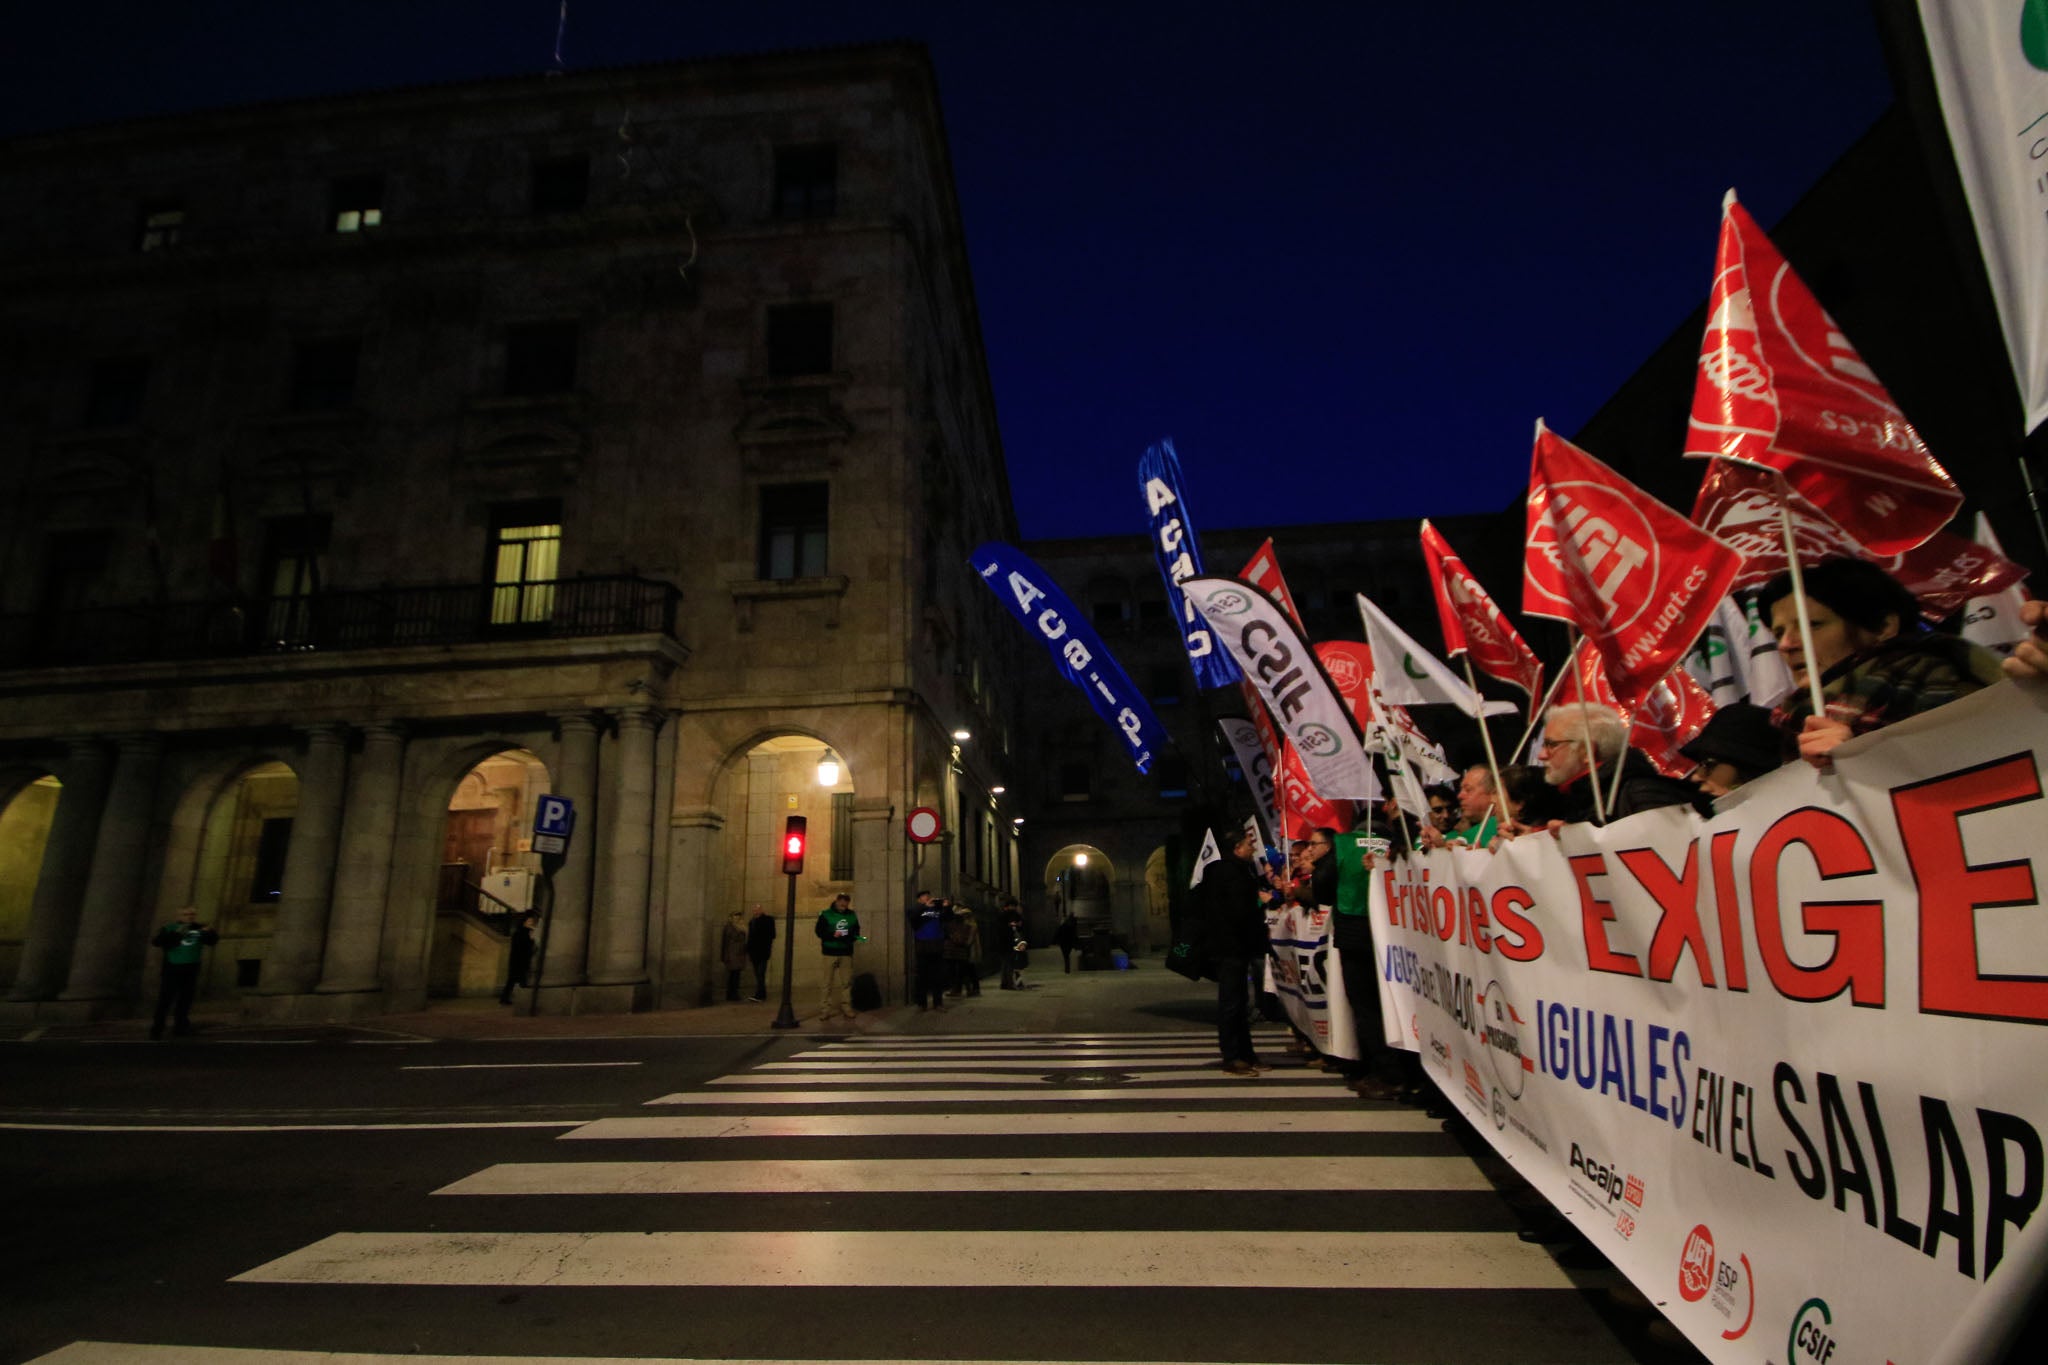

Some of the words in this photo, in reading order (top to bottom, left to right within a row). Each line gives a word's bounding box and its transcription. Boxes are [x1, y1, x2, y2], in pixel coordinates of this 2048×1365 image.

[1007, 570, 1143, 748] Acaip
[541, 800, 566, 829] P
[1536, 1000, 1691, 1130] IGUALES
[1692, 1066, 1725, 1154] EN
[1731, 1080, 1775, 1179] EL
[1569, 1142, 1624, 1204] Acaip
[1717, 1261, 1738, 1292] ESP
[1797, 1321, 1836, 1365] CSIF
